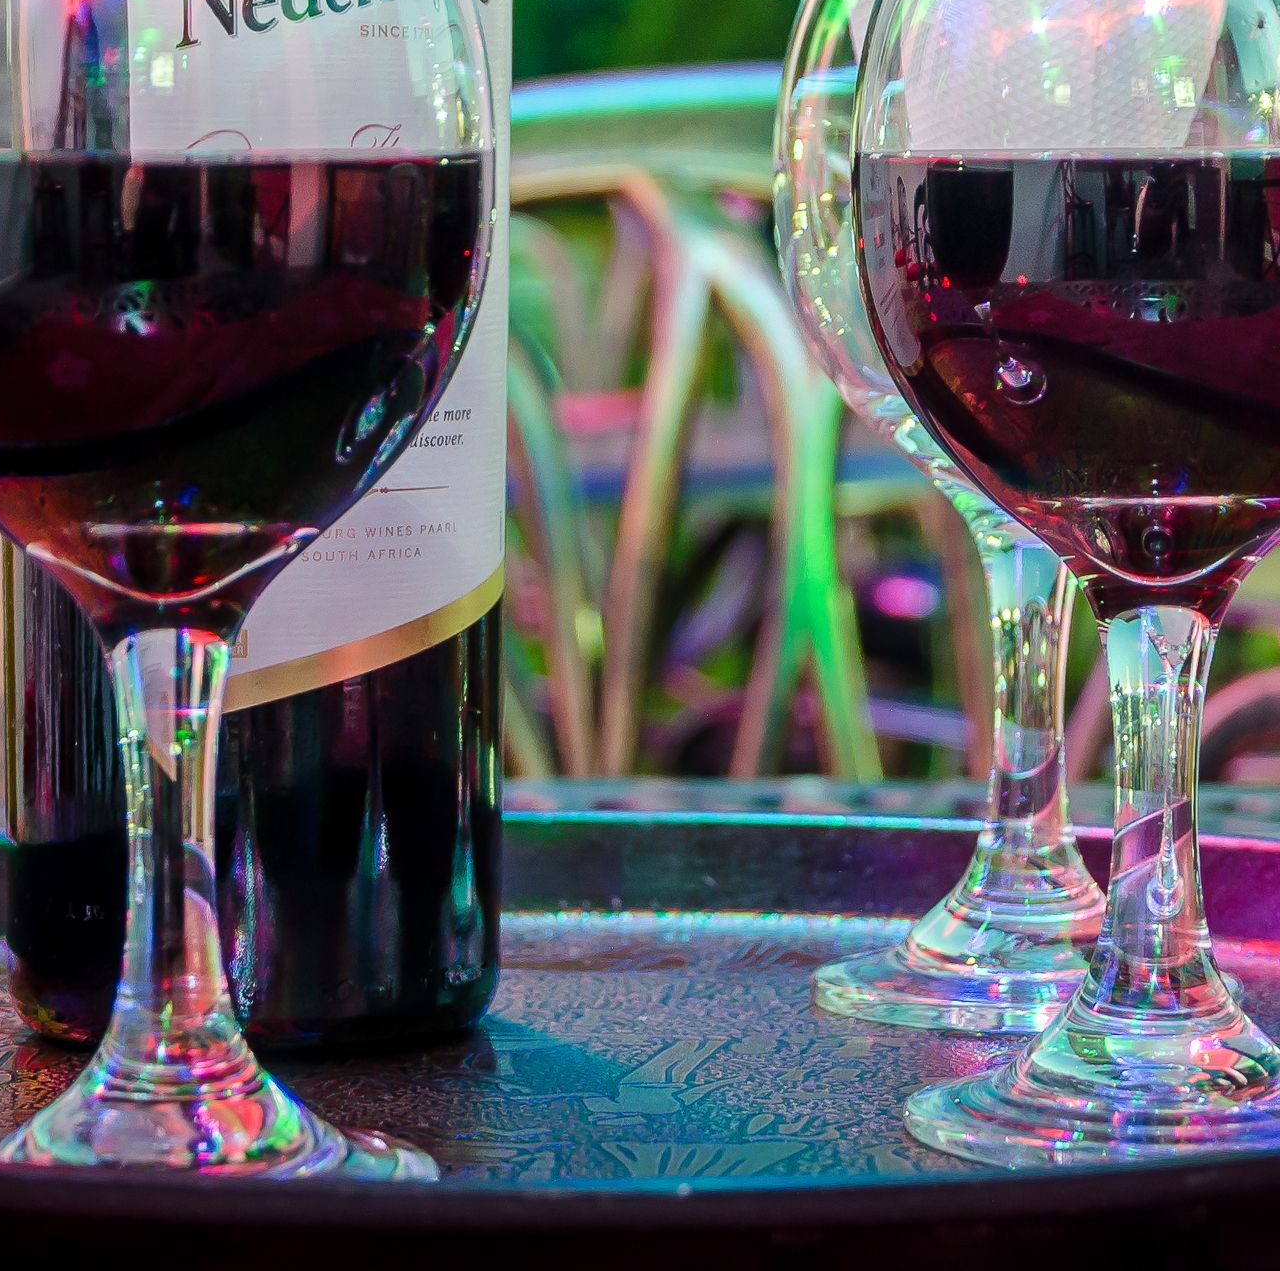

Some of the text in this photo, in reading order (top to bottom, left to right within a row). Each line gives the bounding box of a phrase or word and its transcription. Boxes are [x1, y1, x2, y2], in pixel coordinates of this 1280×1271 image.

[360, 24, 410, 39] SINCE
[443, 408, 472, 422] more
[321, 526, 357, 540] URG
[365, 525, 413, 538] WINES
[301, 547, 422, 562] SOUTH AFRICA
